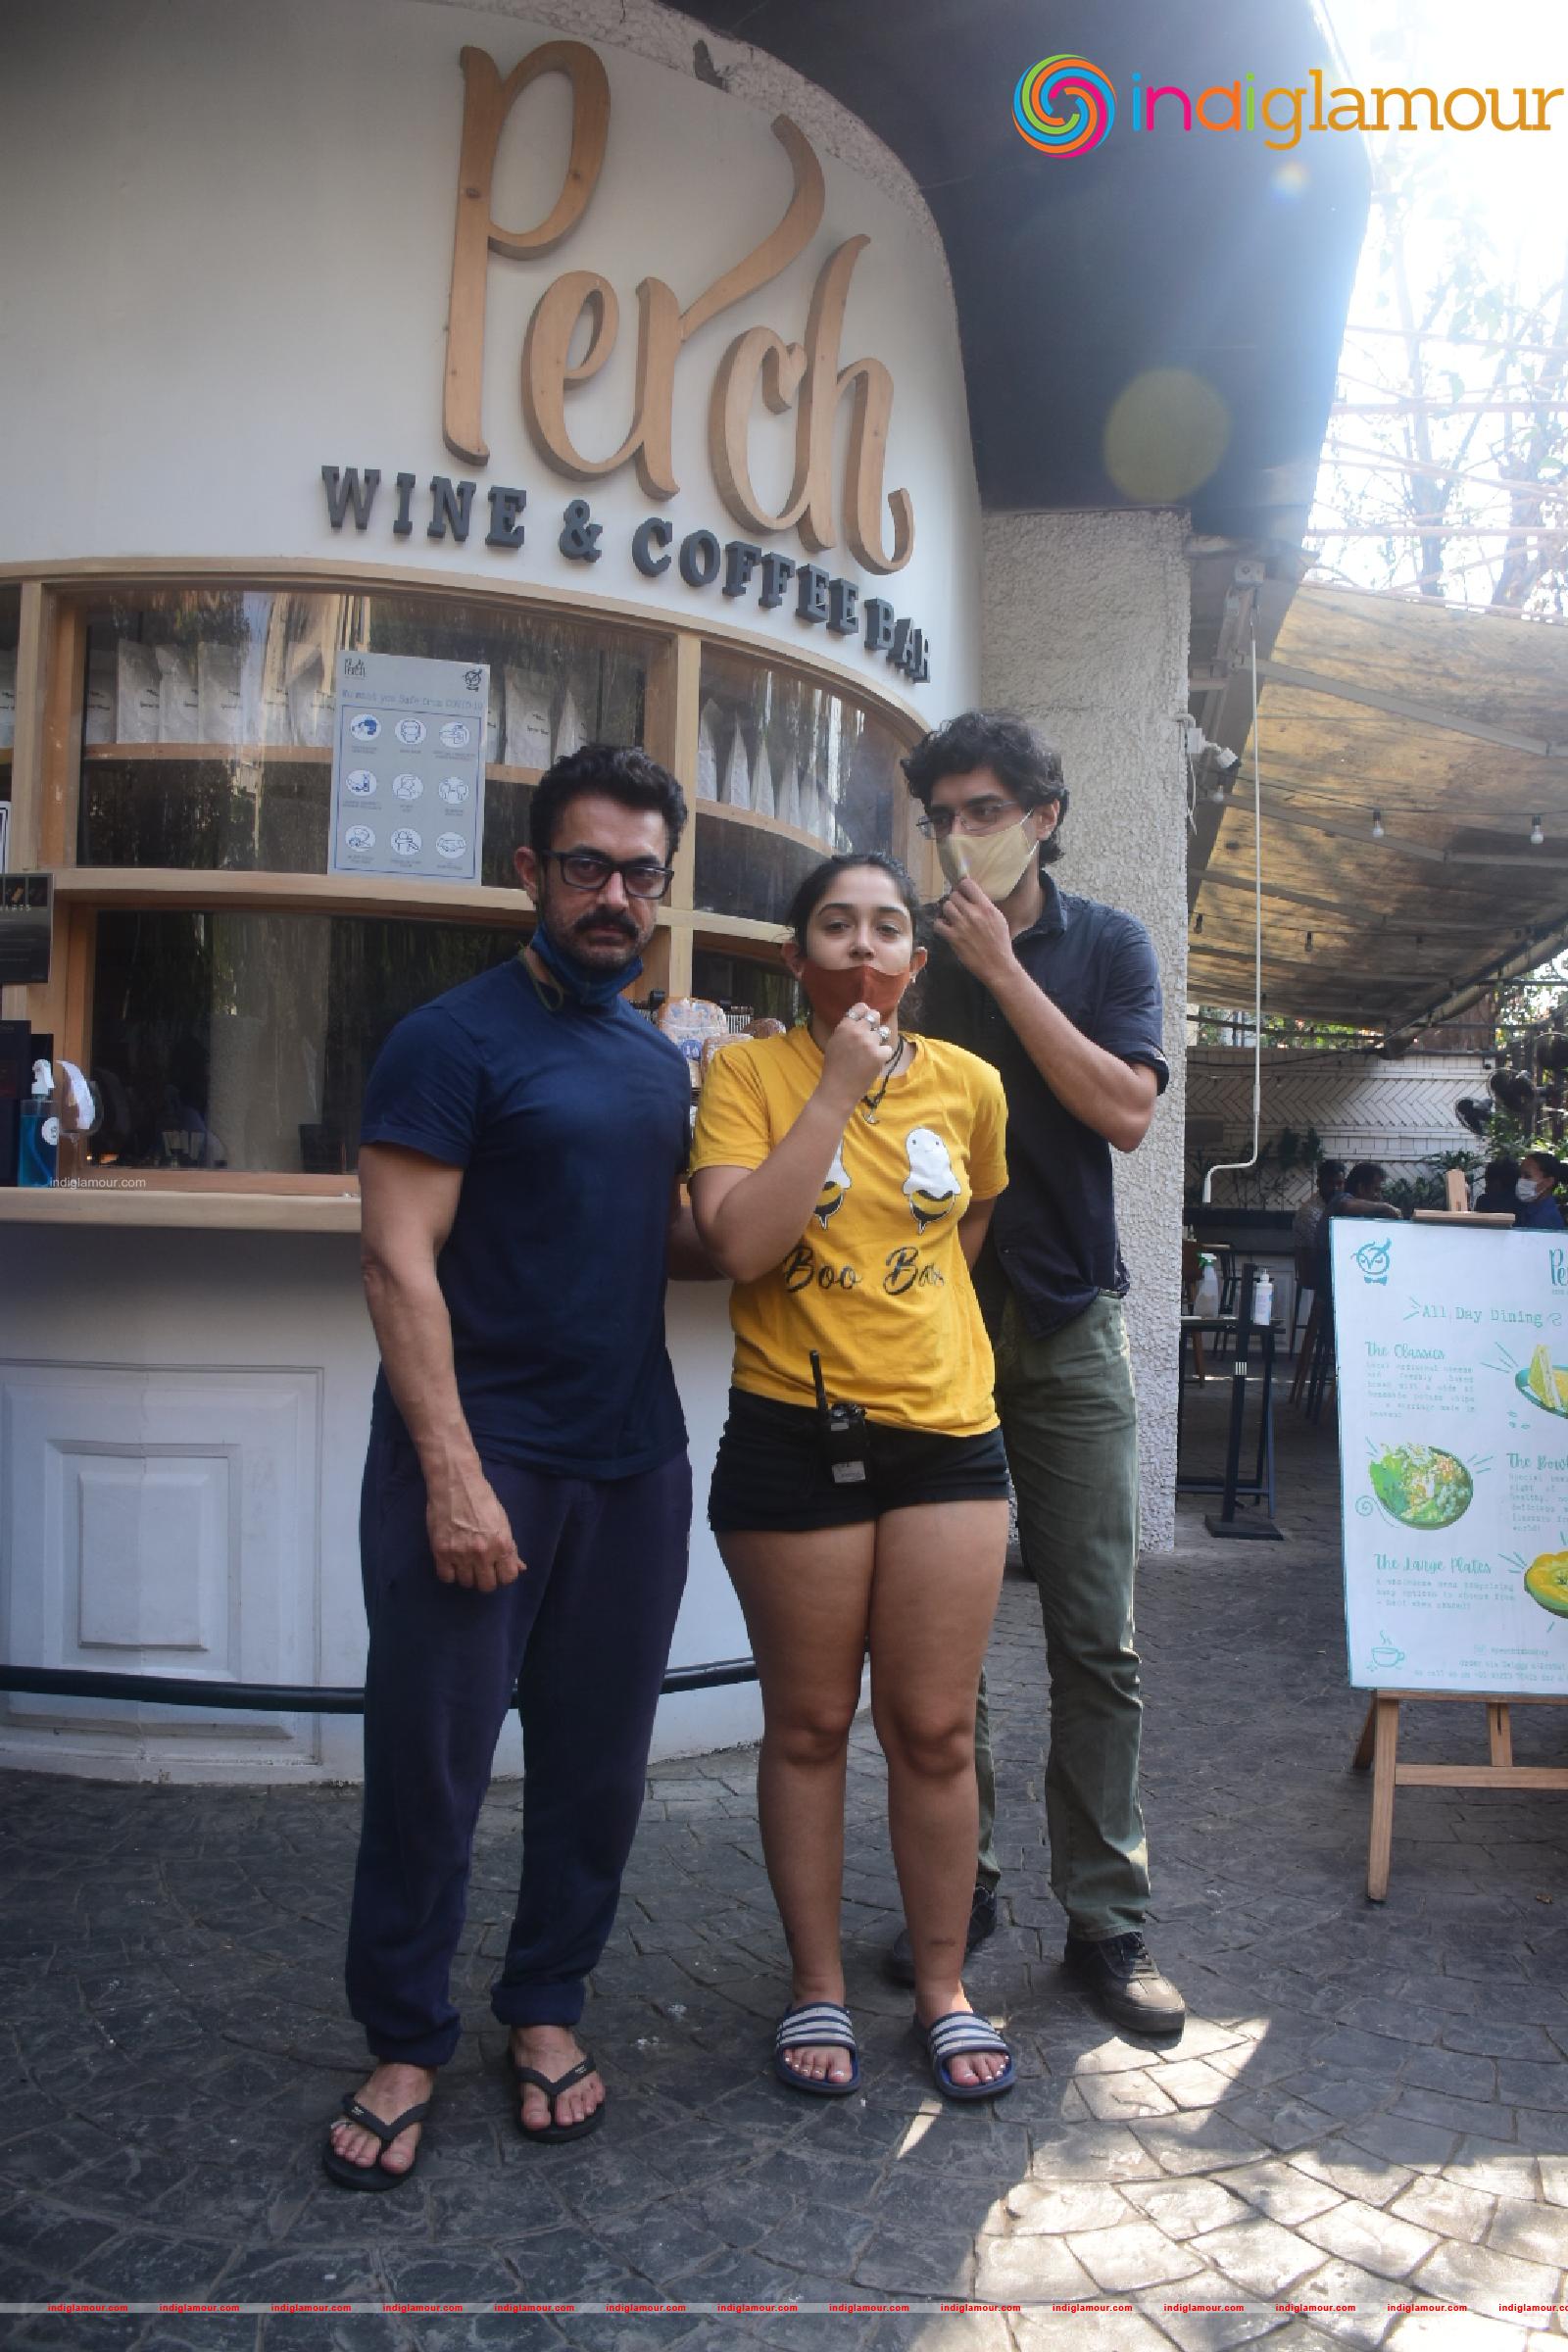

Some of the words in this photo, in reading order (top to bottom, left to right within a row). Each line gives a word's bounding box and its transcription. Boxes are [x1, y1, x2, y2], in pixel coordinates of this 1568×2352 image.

[443, 39, 914, 575] Perch
[321, 466, 526, 548] WINE
[559, 499, 602, 563] &
[631, 516, 859, 635] COFFEE
[784, 1246, 862, 1293] Boo
[1422, 1304, 1446, 1318] All
[1455, 1306, 1483, 1323] Day
[1491, 1307, 1544, 1328] Dining
[1364, 1341, 1388, 1357] The
[1394, 1343, 1445, 1360] Classics
[1506, 1452, 1531, 1468] The
[1374, 1553, 1398, 1570] The
[1403, 1556, 1444, 1574] Large
[1450, 1556, 1492, 1574] Plates
